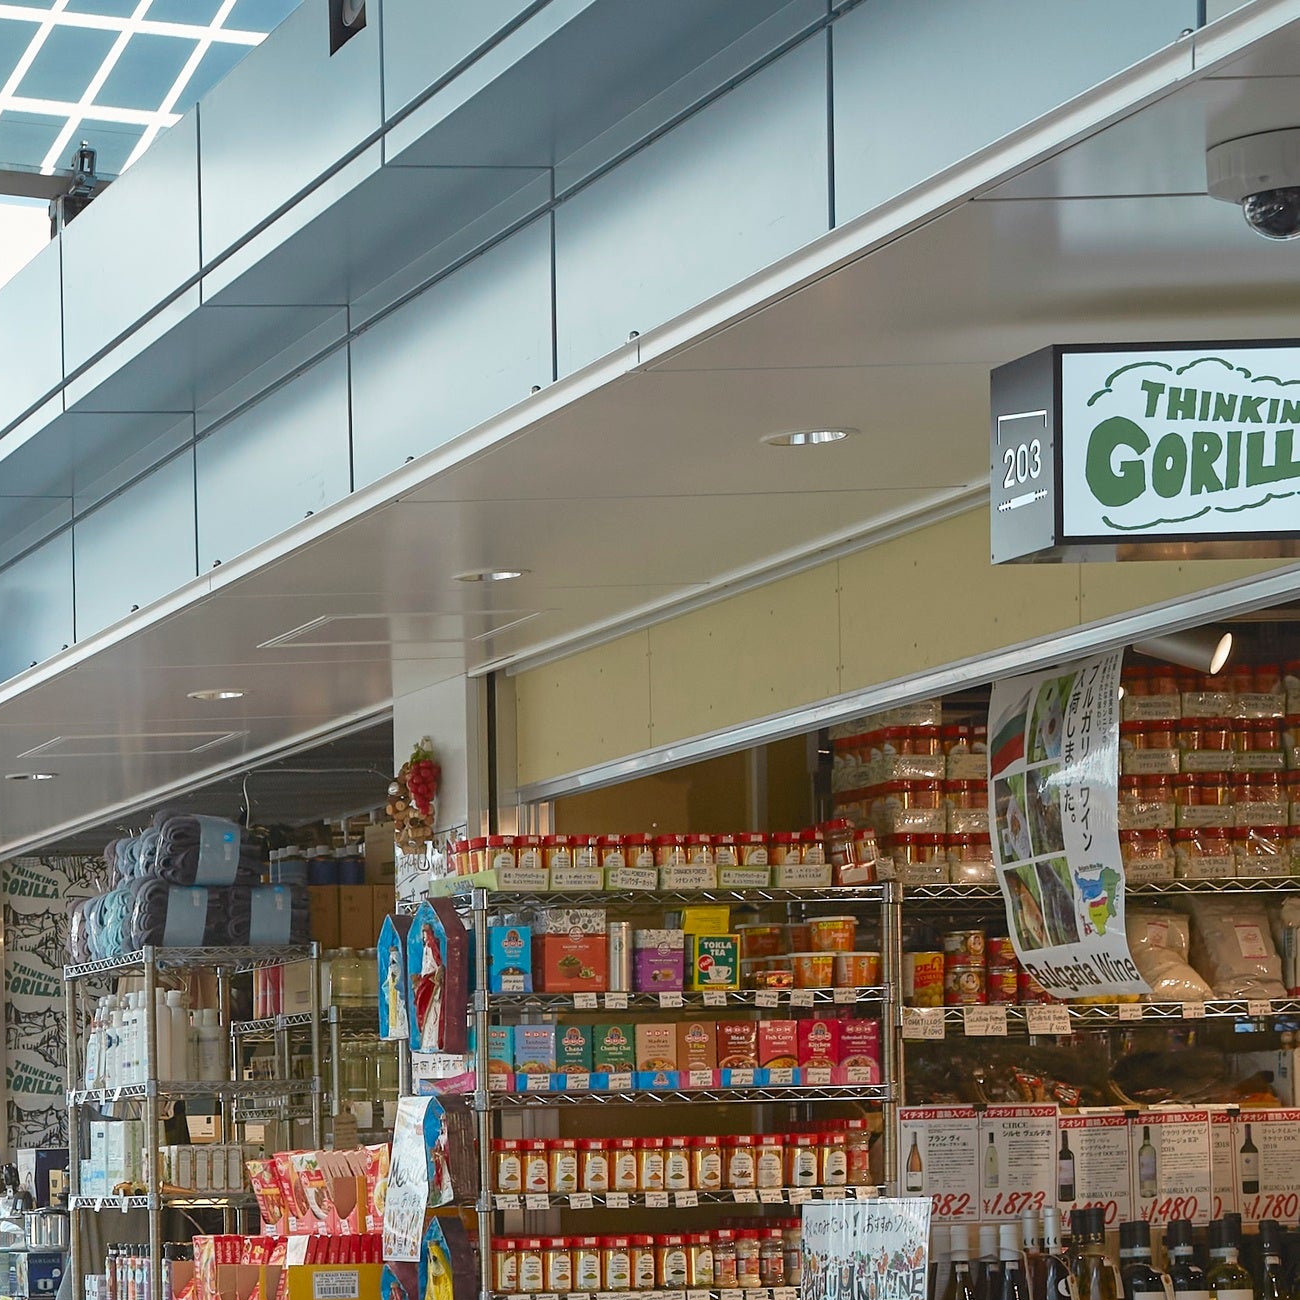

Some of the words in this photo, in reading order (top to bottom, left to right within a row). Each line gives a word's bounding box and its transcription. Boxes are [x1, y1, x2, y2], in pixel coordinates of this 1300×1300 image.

[1002, 438, 1042, 489] 203
[1080, 663, 1102, 851] ブルガリワイン
[10, 863, 59, 886] THINKING
[704, 941, 732, 949] TOKLA
[710, 949, 726, 957] TEA
[12, 961, 61, 984] THINKING
[1024, 956, 1094, 992] Bulgaria
[1090, 953, 1139, 987] Wine
[14, 1060, 63, 1083] THINKING
[1002, 1121, 1029, 1129] CIRCE
[1059, 1119, 1085, 1128] チオシ!
[1140, 1196, 1199, 1224] ¥1,480
